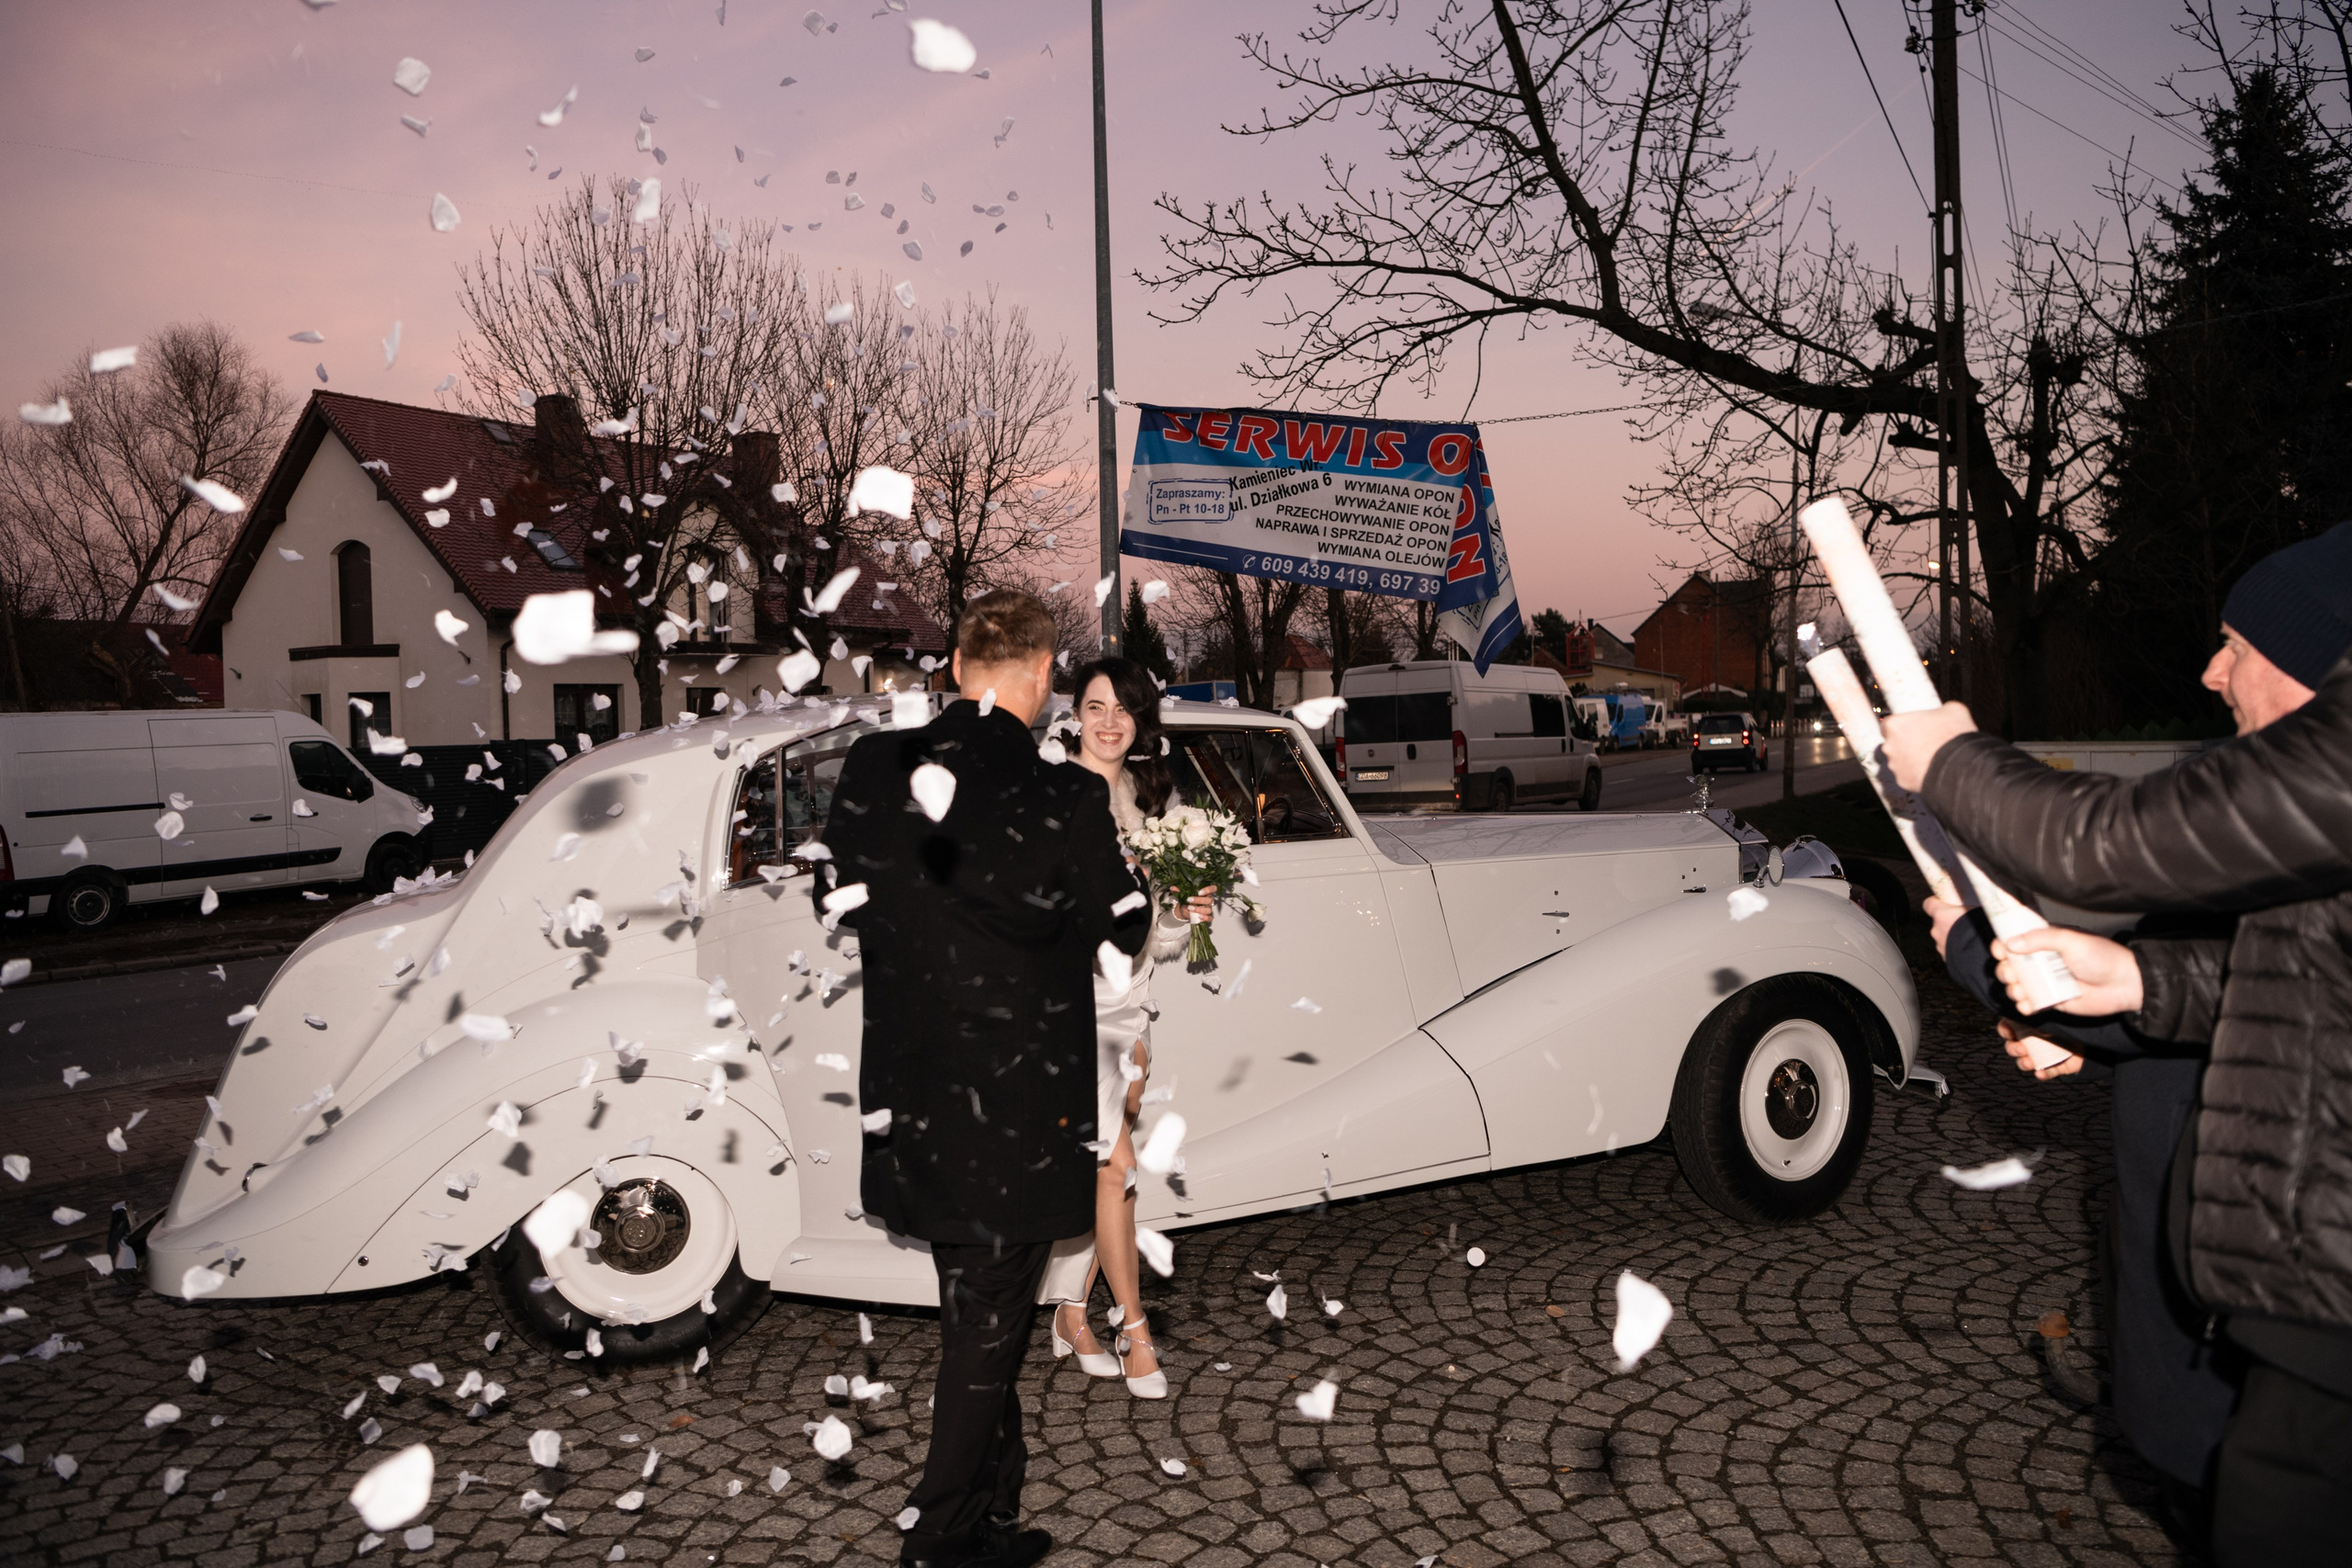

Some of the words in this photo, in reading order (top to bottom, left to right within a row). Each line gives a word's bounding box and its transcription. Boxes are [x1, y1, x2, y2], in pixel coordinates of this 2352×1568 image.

[1162, 411, 1407, 470] SERWIS
[1229, 466, 1296, 492] Kamieniec
[1299, 459, 1324, 474] Wr.
[1231, 497, 1248, 513] ul.
[1251, 478, 1319, 508] Działkowa
[1322, 471, 1332, 487] 6
[1344, 479, 1410, 498] WYMIANA
[1414, 488, 1455, 503] OPON
[1156, 488, 1226, 502] Zapraszamy:
[1156, 504, 1170, 514] Pn
[1180, 503, 1191, 514] Pt
[1194, 503, 1225, 514] 10-18
[1335, 495, 1419, 516] WYWAŻANIE
[1423, 504, 1453, 520] KÓŁ
[1255, 517, 1320, 536] NAPRAWA
[1323, 526, 1328, 537] I
[1330, 526, 1403, 547] SPRZEDAŻ
[1407, 536, 1448, 553] OPON
[1276, 503, 1406, 531] PRZECHOWYWANIE
[1409, 520, 1450, 536] OPON
[1317, 541, 1382, 560] WYMIANA
[1385, 550, 1446, 569] OLEJÓW
[1261, 556, 1294, 574] 609
[1297, 561, 1331, 581] 439
[1334, 567, 1374, 589] 419,
[1379, 572, 1414, 592] 697
